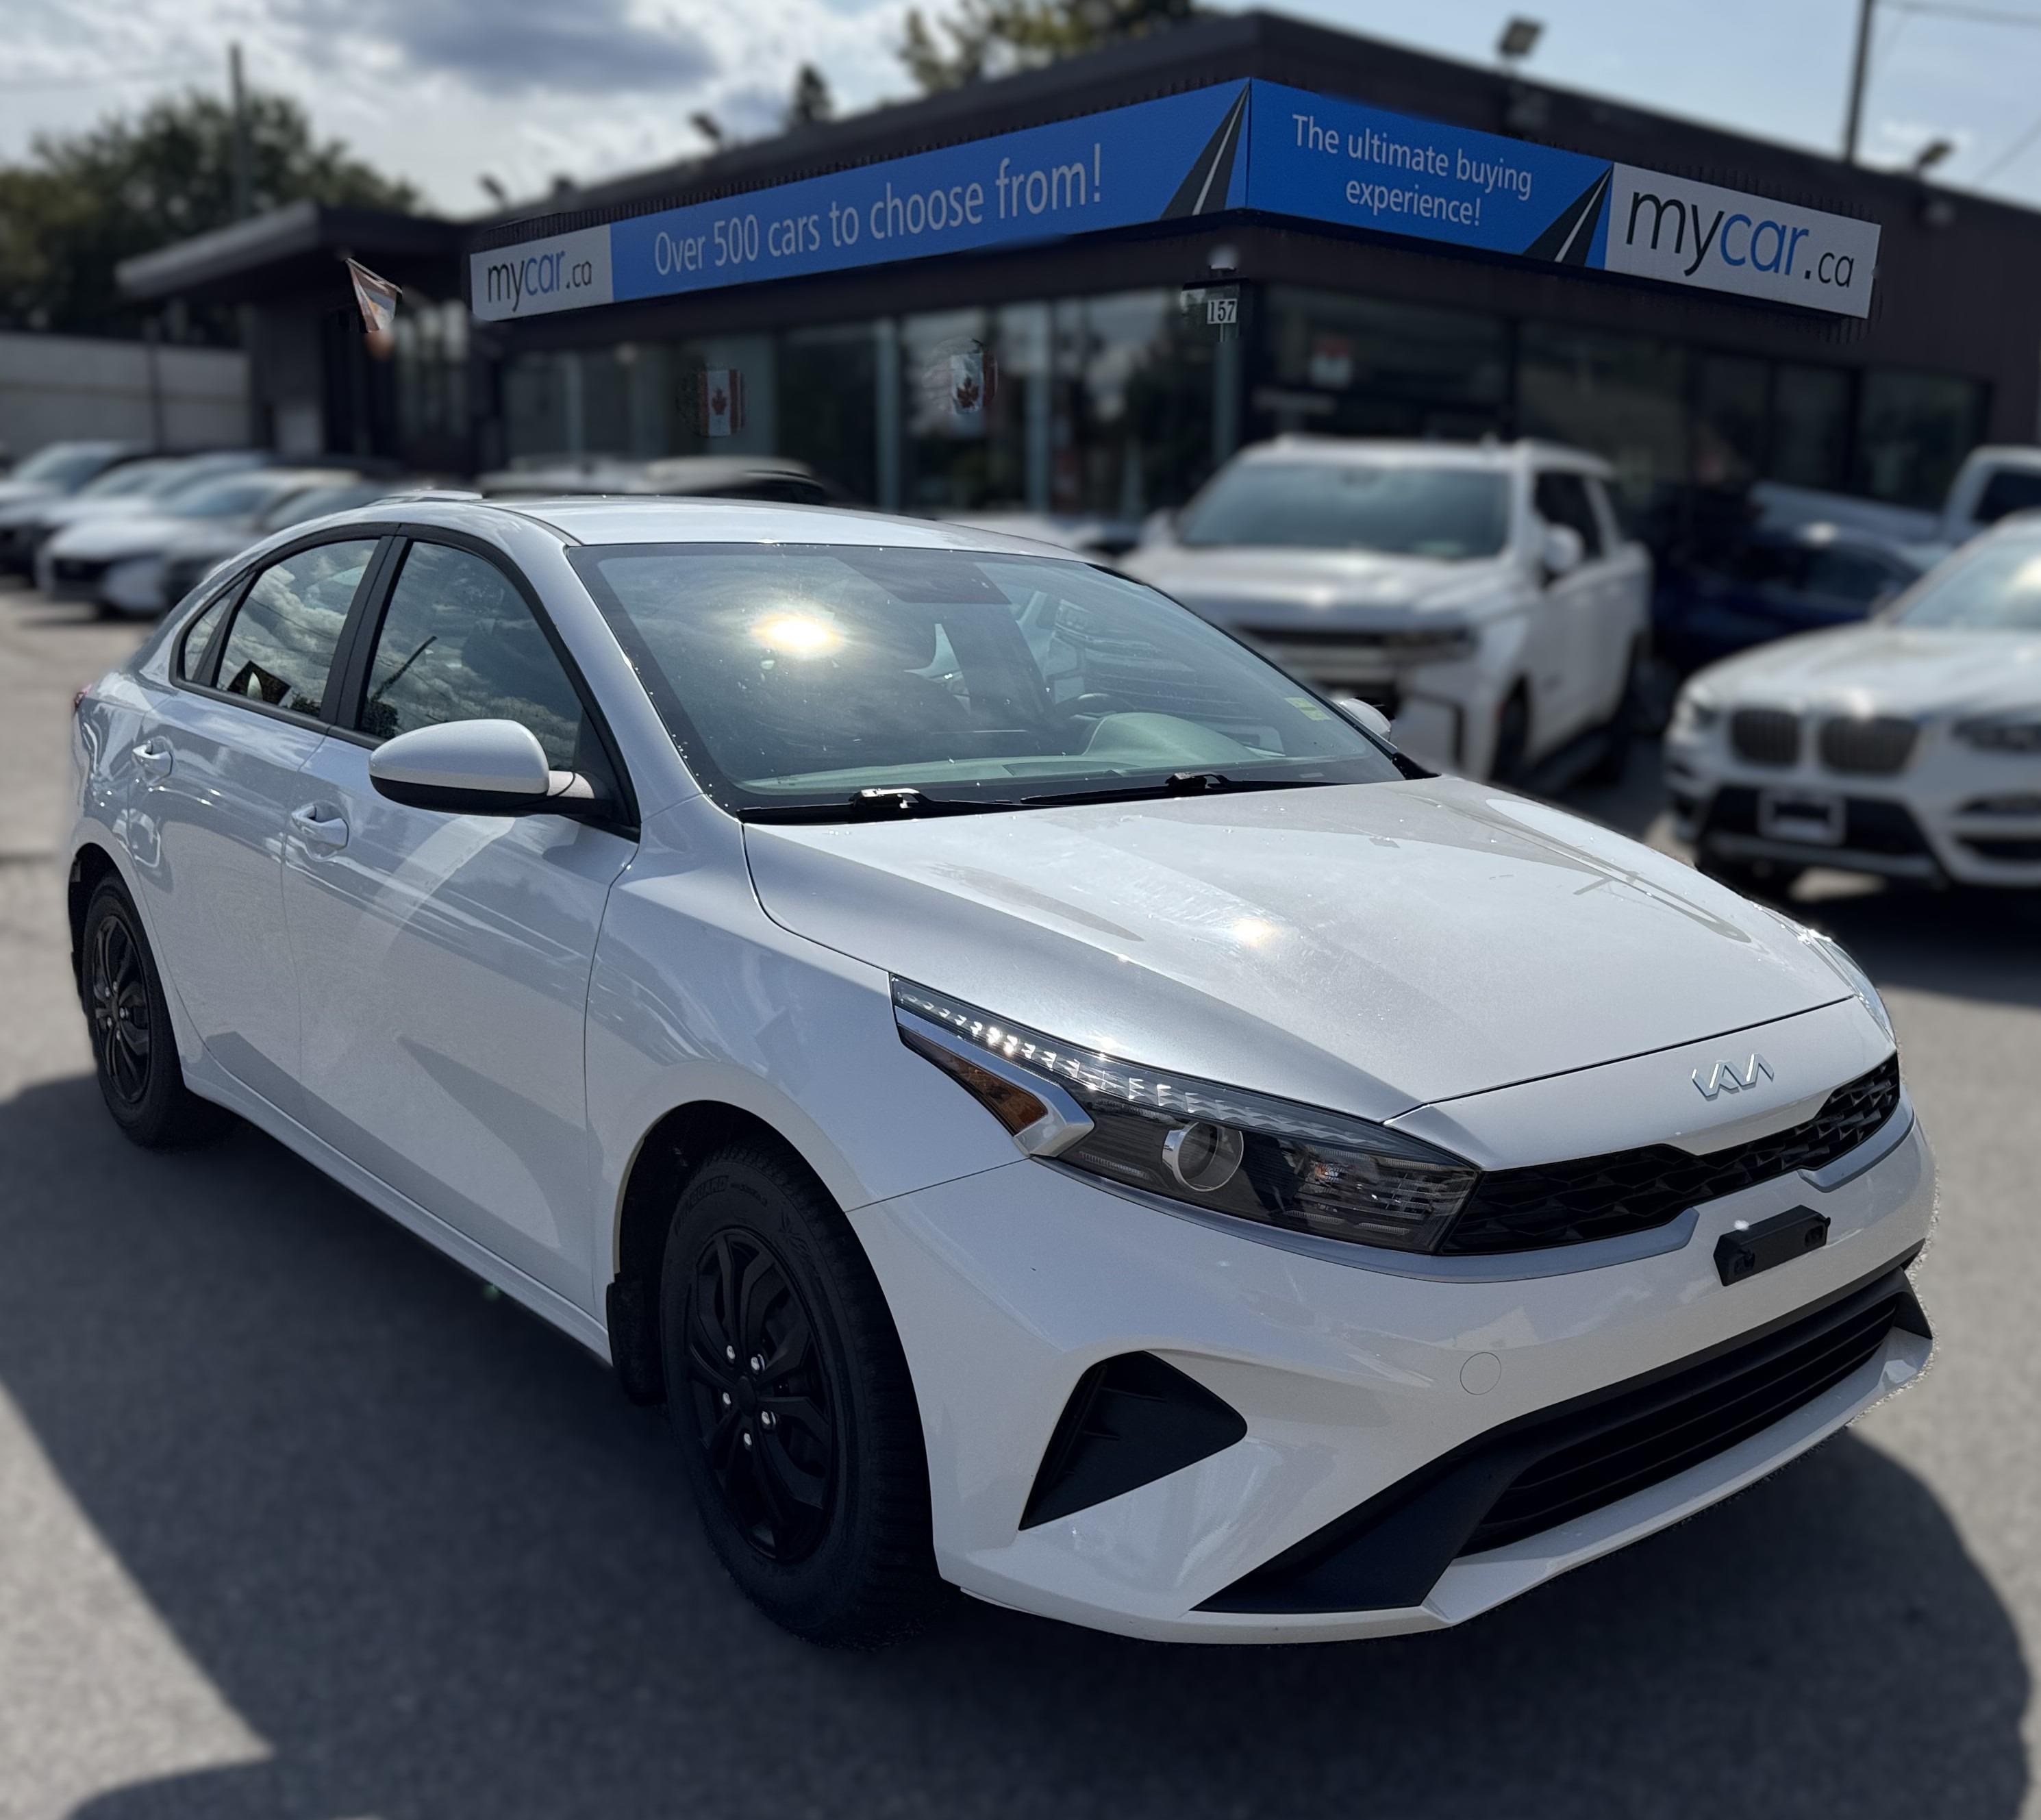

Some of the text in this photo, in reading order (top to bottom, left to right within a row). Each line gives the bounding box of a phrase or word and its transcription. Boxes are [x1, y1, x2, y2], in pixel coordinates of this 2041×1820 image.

[1292, 113, 1532, 201] The ultimate buying
[654, 143, 1101, 275] Over 500 cars to choose from!
[1345, 179, 1481, 226] experience!
[1625, 192, 1854, 288] mycar.ca
[487, 250, 592, 311] mycar.ca
[1210, 300, 1236, 322] 157
